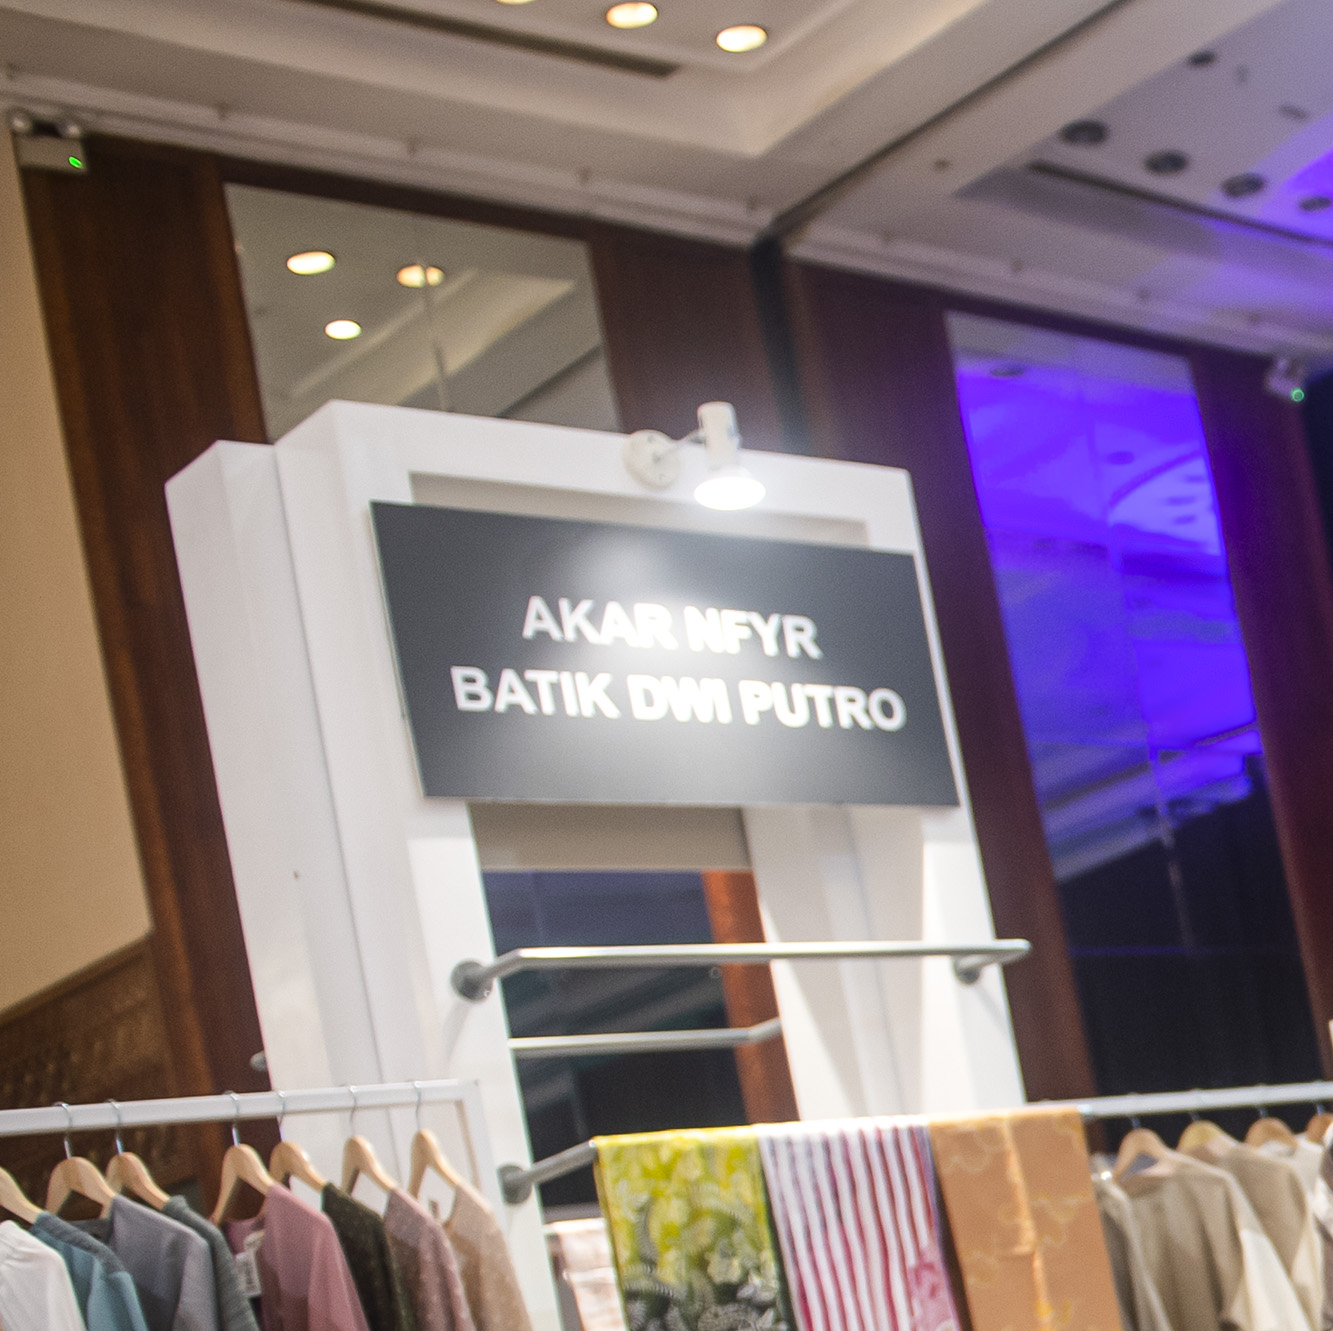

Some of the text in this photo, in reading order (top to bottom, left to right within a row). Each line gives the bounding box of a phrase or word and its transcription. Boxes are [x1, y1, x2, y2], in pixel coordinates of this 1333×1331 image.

[522, 595, 823, 659] AKAR NFYR
[450, 664, 906, 730] BATIK DWI PUTRO
